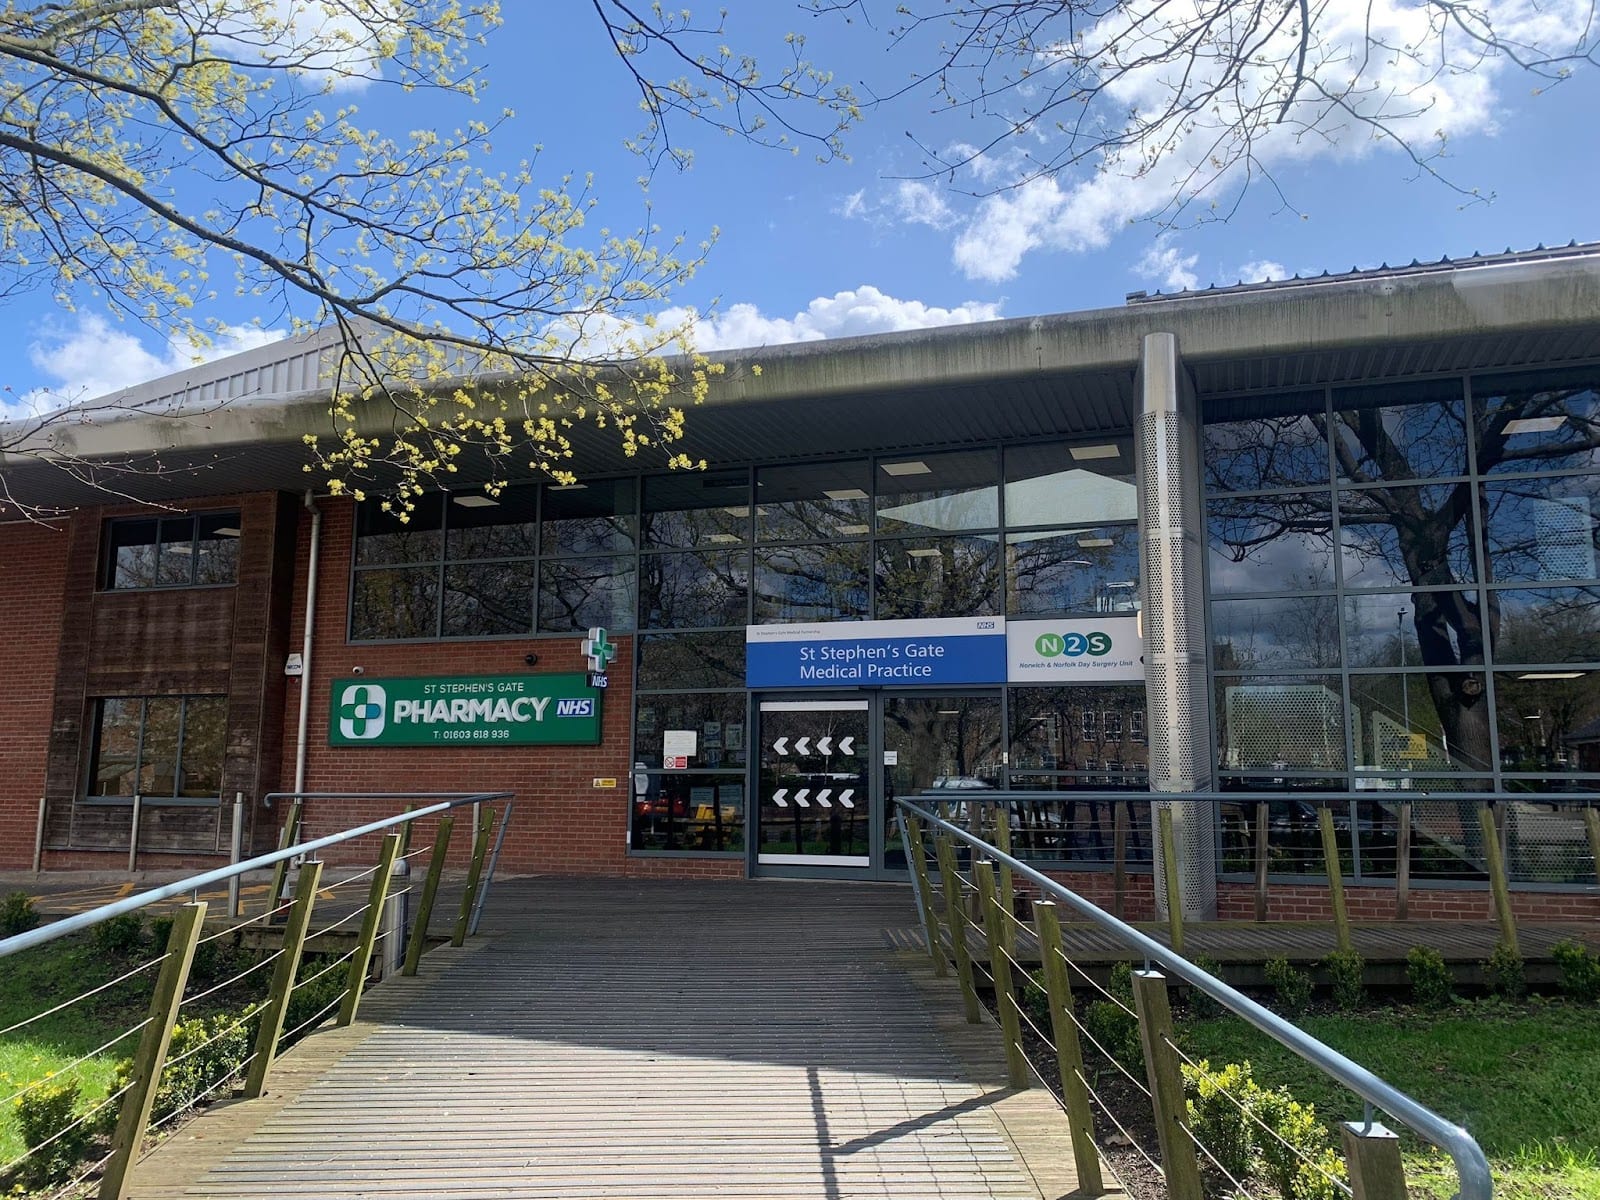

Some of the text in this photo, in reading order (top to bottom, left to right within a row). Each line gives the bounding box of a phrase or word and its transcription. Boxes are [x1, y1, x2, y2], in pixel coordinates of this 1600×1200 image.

[1041, 636, 1105, 653] N2S
[800, 643, 944, 662] St Stephen's Gate
[800, 662, 932, 679] Medical Practice
[1078, 661, 1090, 669] Day
[1092, 660, 1118, 669] Surgery
[424, 682, 524, 694] ST STEPHEN'S GATE
[592, 675, 607, 687] NHS
[393, 697, 551, 724] PHARMACY
[556, 700, 591, 715] NHS
[433, 730, 441, 739] T:
[443, 730, 471, 739] 01603
[491, 729, 509, 739] 936
